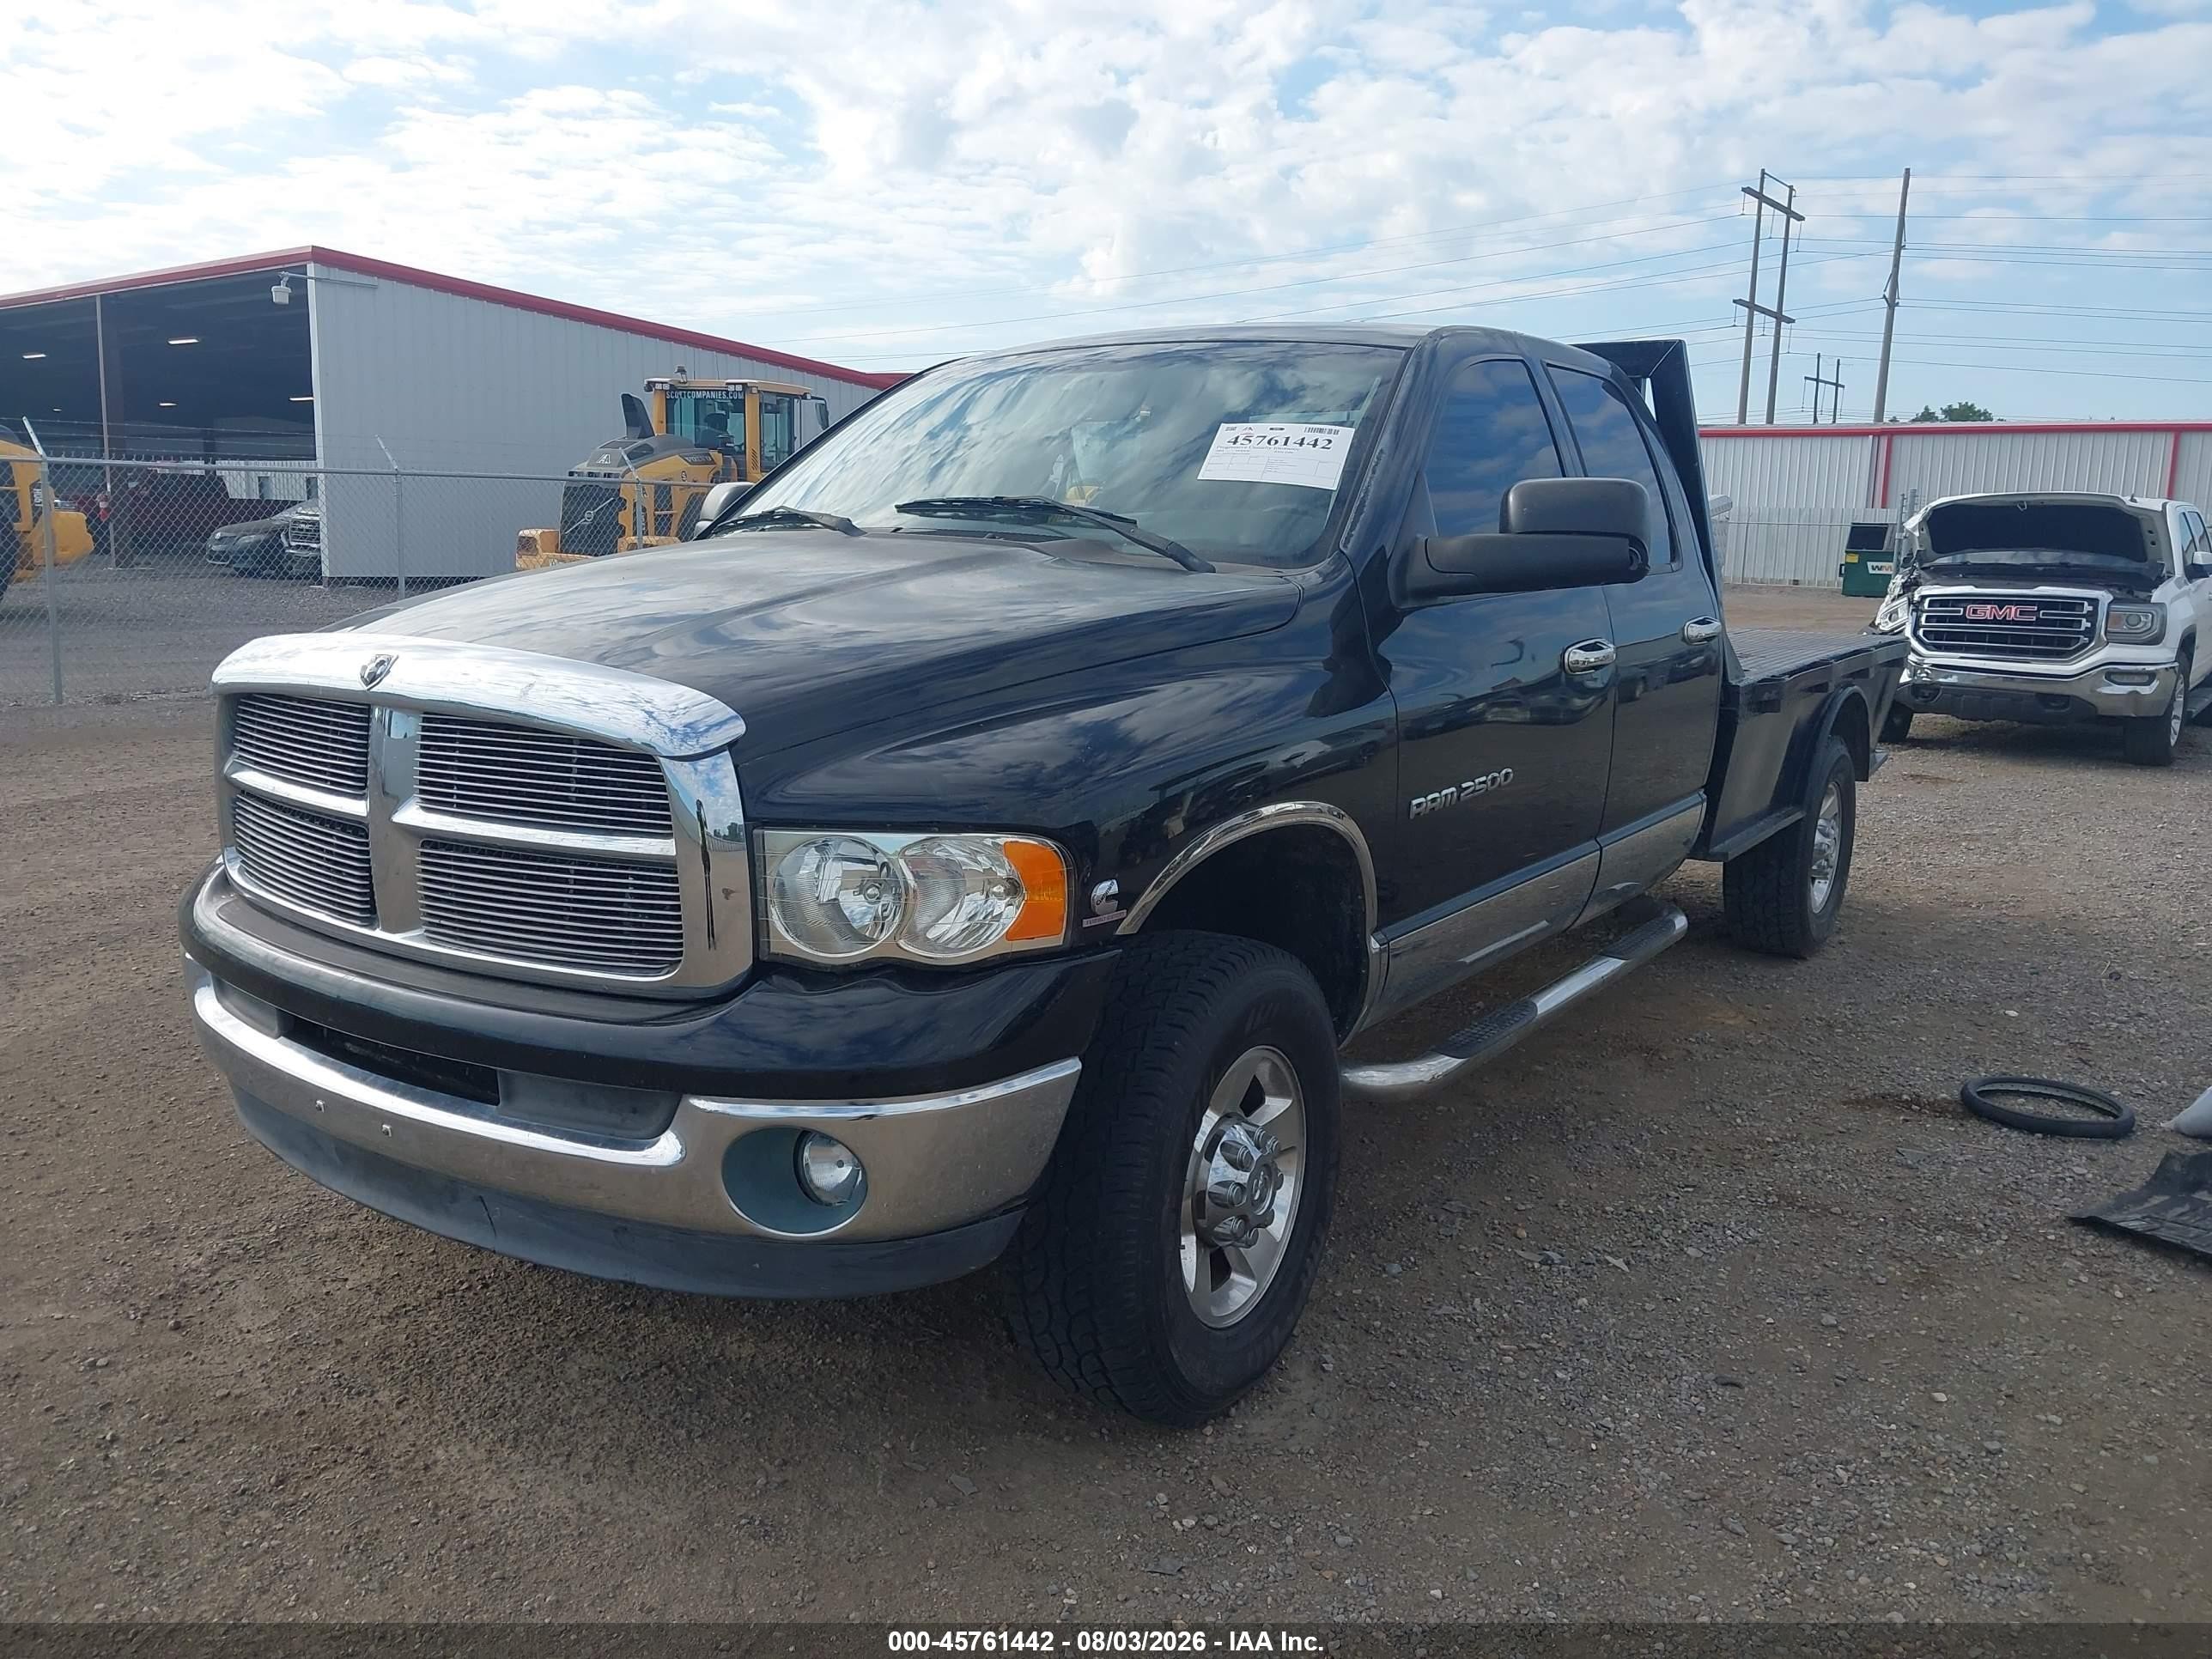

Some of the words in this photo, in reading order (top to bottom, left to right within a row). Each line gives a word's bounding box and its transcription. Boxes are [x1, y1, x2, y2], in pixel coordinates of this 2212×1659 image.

[665, 391, 744, 399] SCOTTCOMPANIES.COM
[1227, 434, 1334, 450] 45761442
[1966, 605, 2038, 621] GMC
[1410, 787, 1457, 819] RAM
[1460, 767, 1514, 801] 2500
